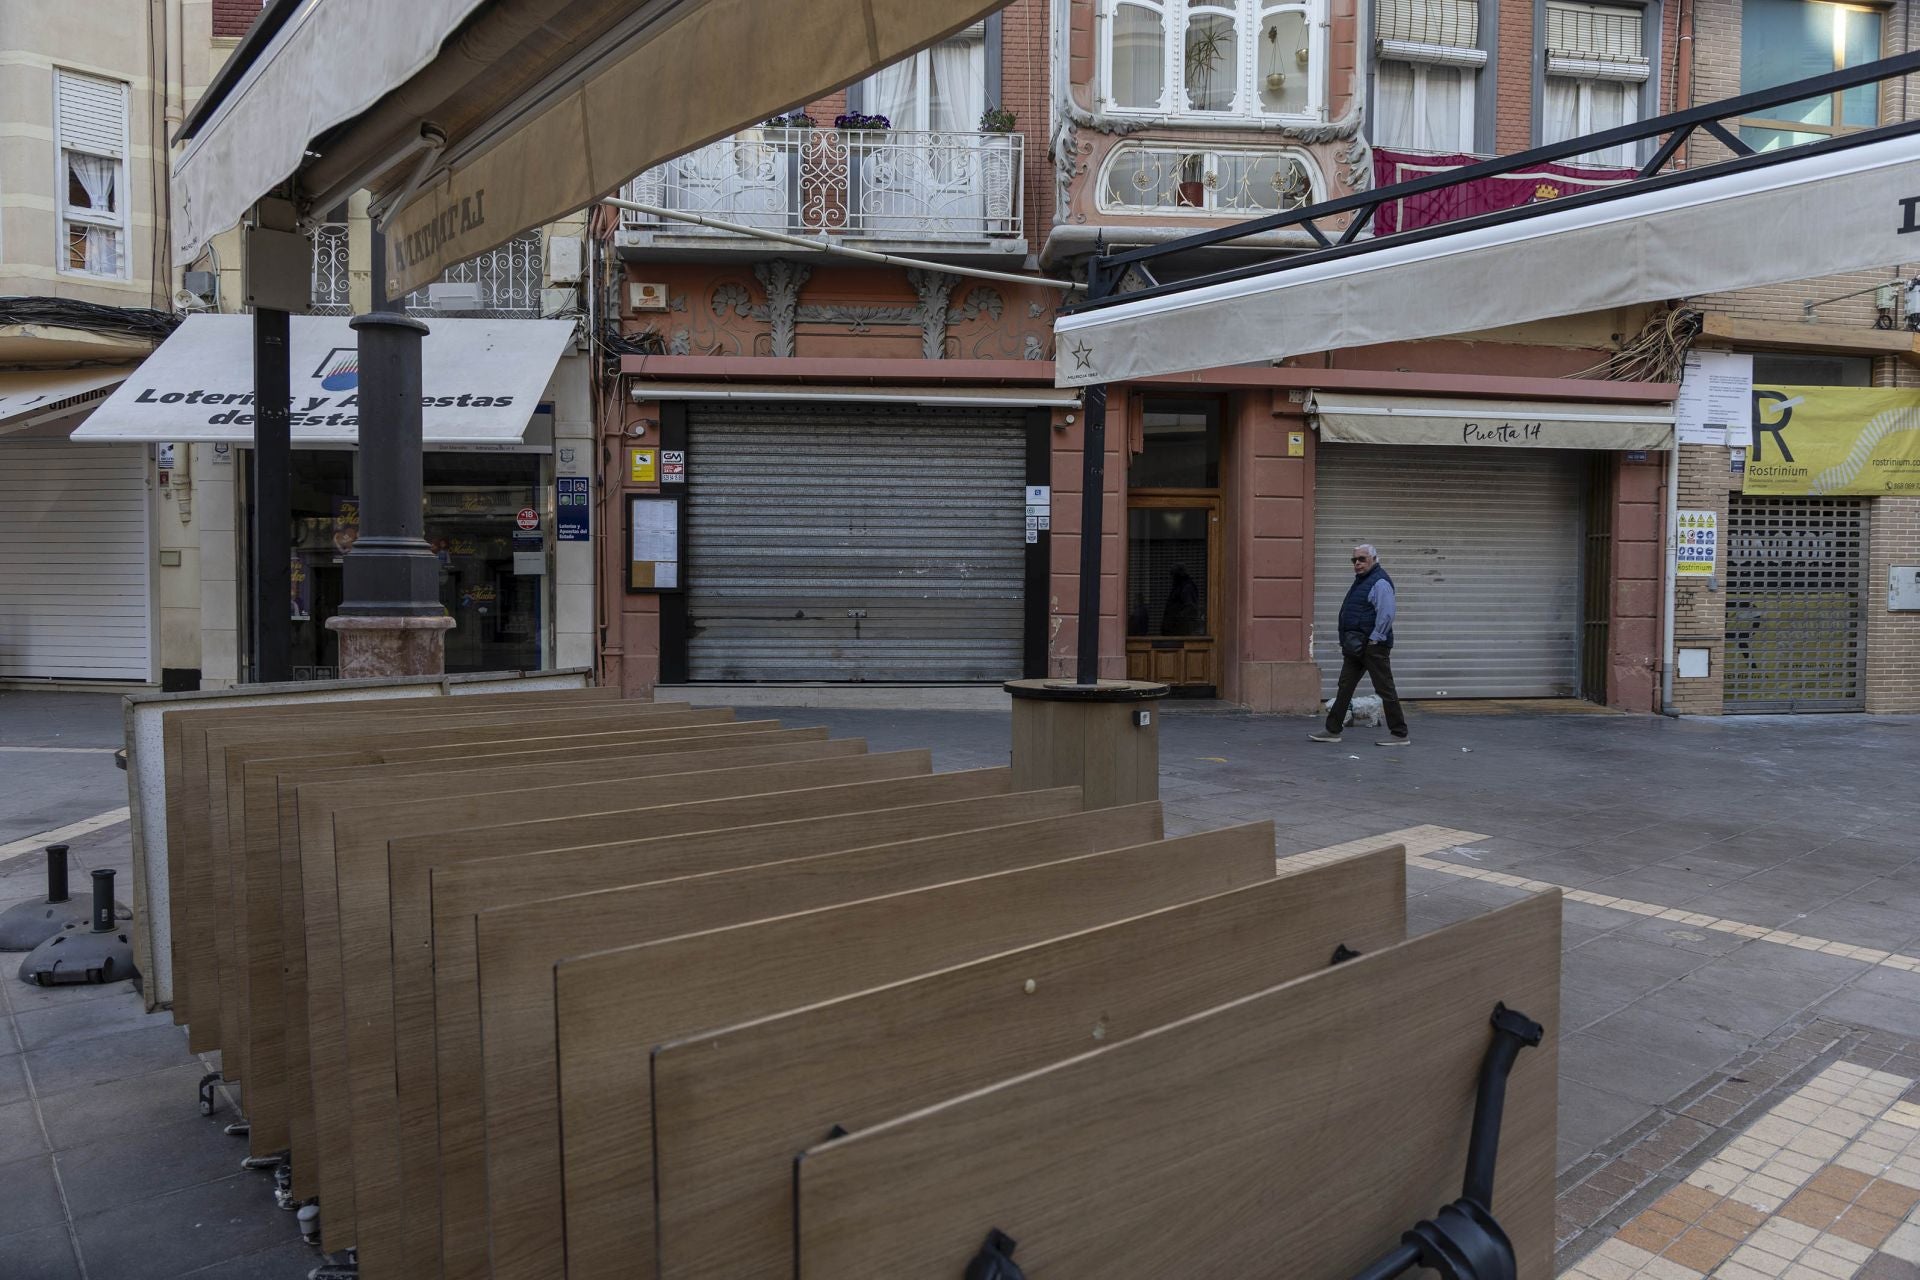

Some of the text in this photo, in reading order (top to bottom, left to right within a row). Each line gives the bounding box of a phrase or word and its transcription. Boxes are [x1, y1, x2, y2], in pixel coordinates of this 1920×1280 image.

[134, 389, 514, 411] Loterí y Aestas
[208, 410, 359, 426] de Esta
[1752, 389, 1795, 462] R
[1463, 422, 1542, 444] Puerta 14
[1749, 465, 1808, 477] Rostrinium
[1677, 562, 1713, 572] Rostrinium
